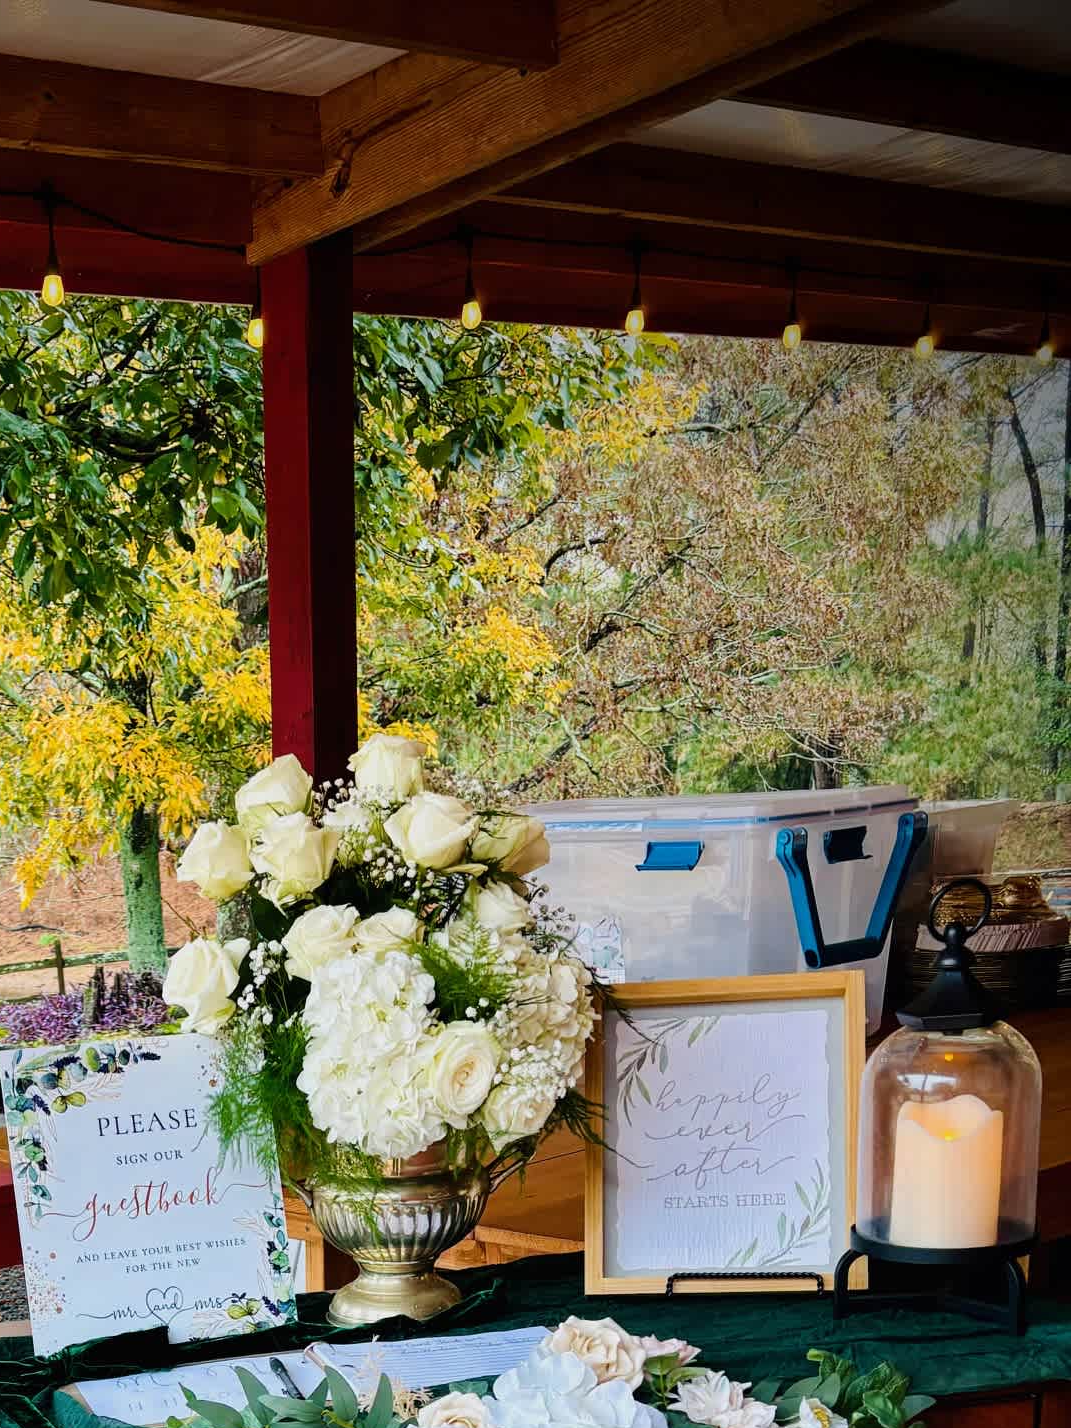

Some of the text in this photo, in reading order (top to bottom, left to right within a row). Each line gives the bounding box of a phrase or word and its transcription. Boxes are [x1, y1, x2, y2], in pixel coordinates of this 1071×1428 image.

[655, 1073, 802, 1120] happily
[97, 1108, 199, 1137] PLEASE
[645, 1114, 806, 1144] ever
[115, 1149, 184, 1166] SIGN OUR
[647, 1141, 796, 1189] after
[41, 1166, 269, 1242] guestbook
[664, 1191, 787, 1209] STARTS HERE
[76, 1237, 246, 1264] AND LEAVE YOUR BEST WISHES
[125, 1258, 201, 1273] FOR THE NEW
[153, 1292, 182, 1311] and
[194, 1297, 225, 1311] mrs
